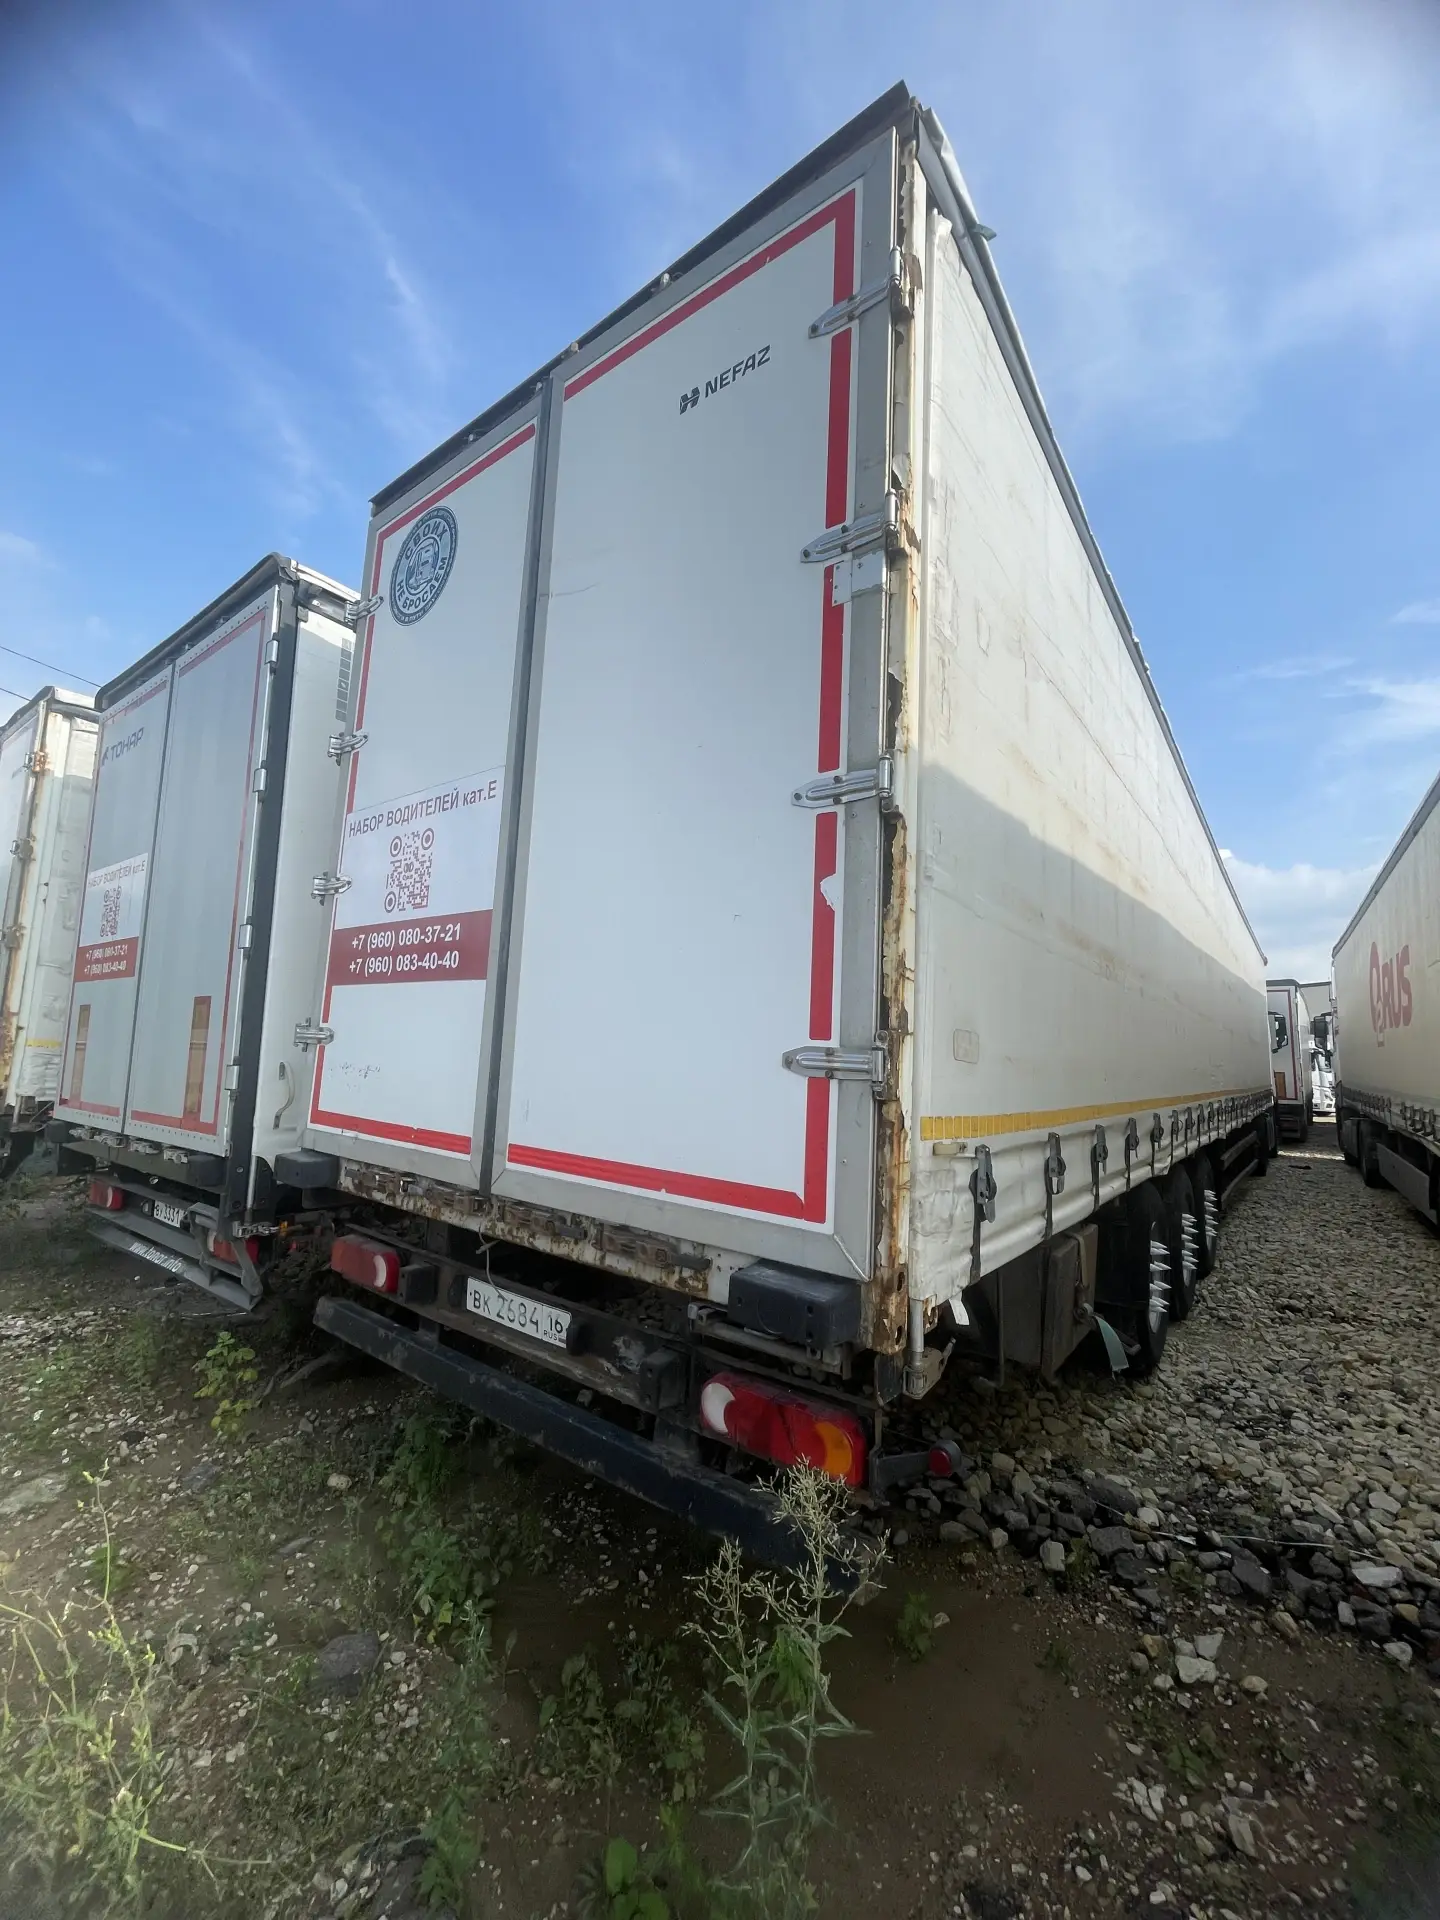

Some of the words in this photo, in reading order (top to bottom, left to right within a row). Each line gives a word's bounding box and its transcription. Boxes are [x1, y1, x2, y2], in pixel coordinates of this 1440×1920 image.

[705, 344, 771, 398] NEFAZ
[405, 519, 448, 561] СВОИХ
[396, 579, 407, 602] НЕ
[402, 556, 448, 611] БРОСАЕМ
[110, 727, 145, 761] ТОНАР
[349, 813, 384, 838] НАБОР
[386, 787, 459, 827] ВОДИТЕЛЕЙ
[351, 934, 366, 950] +7
[367, 930, 396, 953] (960)
[398, 922, 461, 946] 080-37-21
[349, 958, 363, 974] +7
[364, 955, 393, 977] (960)
[396, 950, 460, 972] 083-40-40
[496, 1294, 539, 1333] 2684
[547, 1311, 564, 1334] 16
[543, 1329, 558, 1341] RUS
